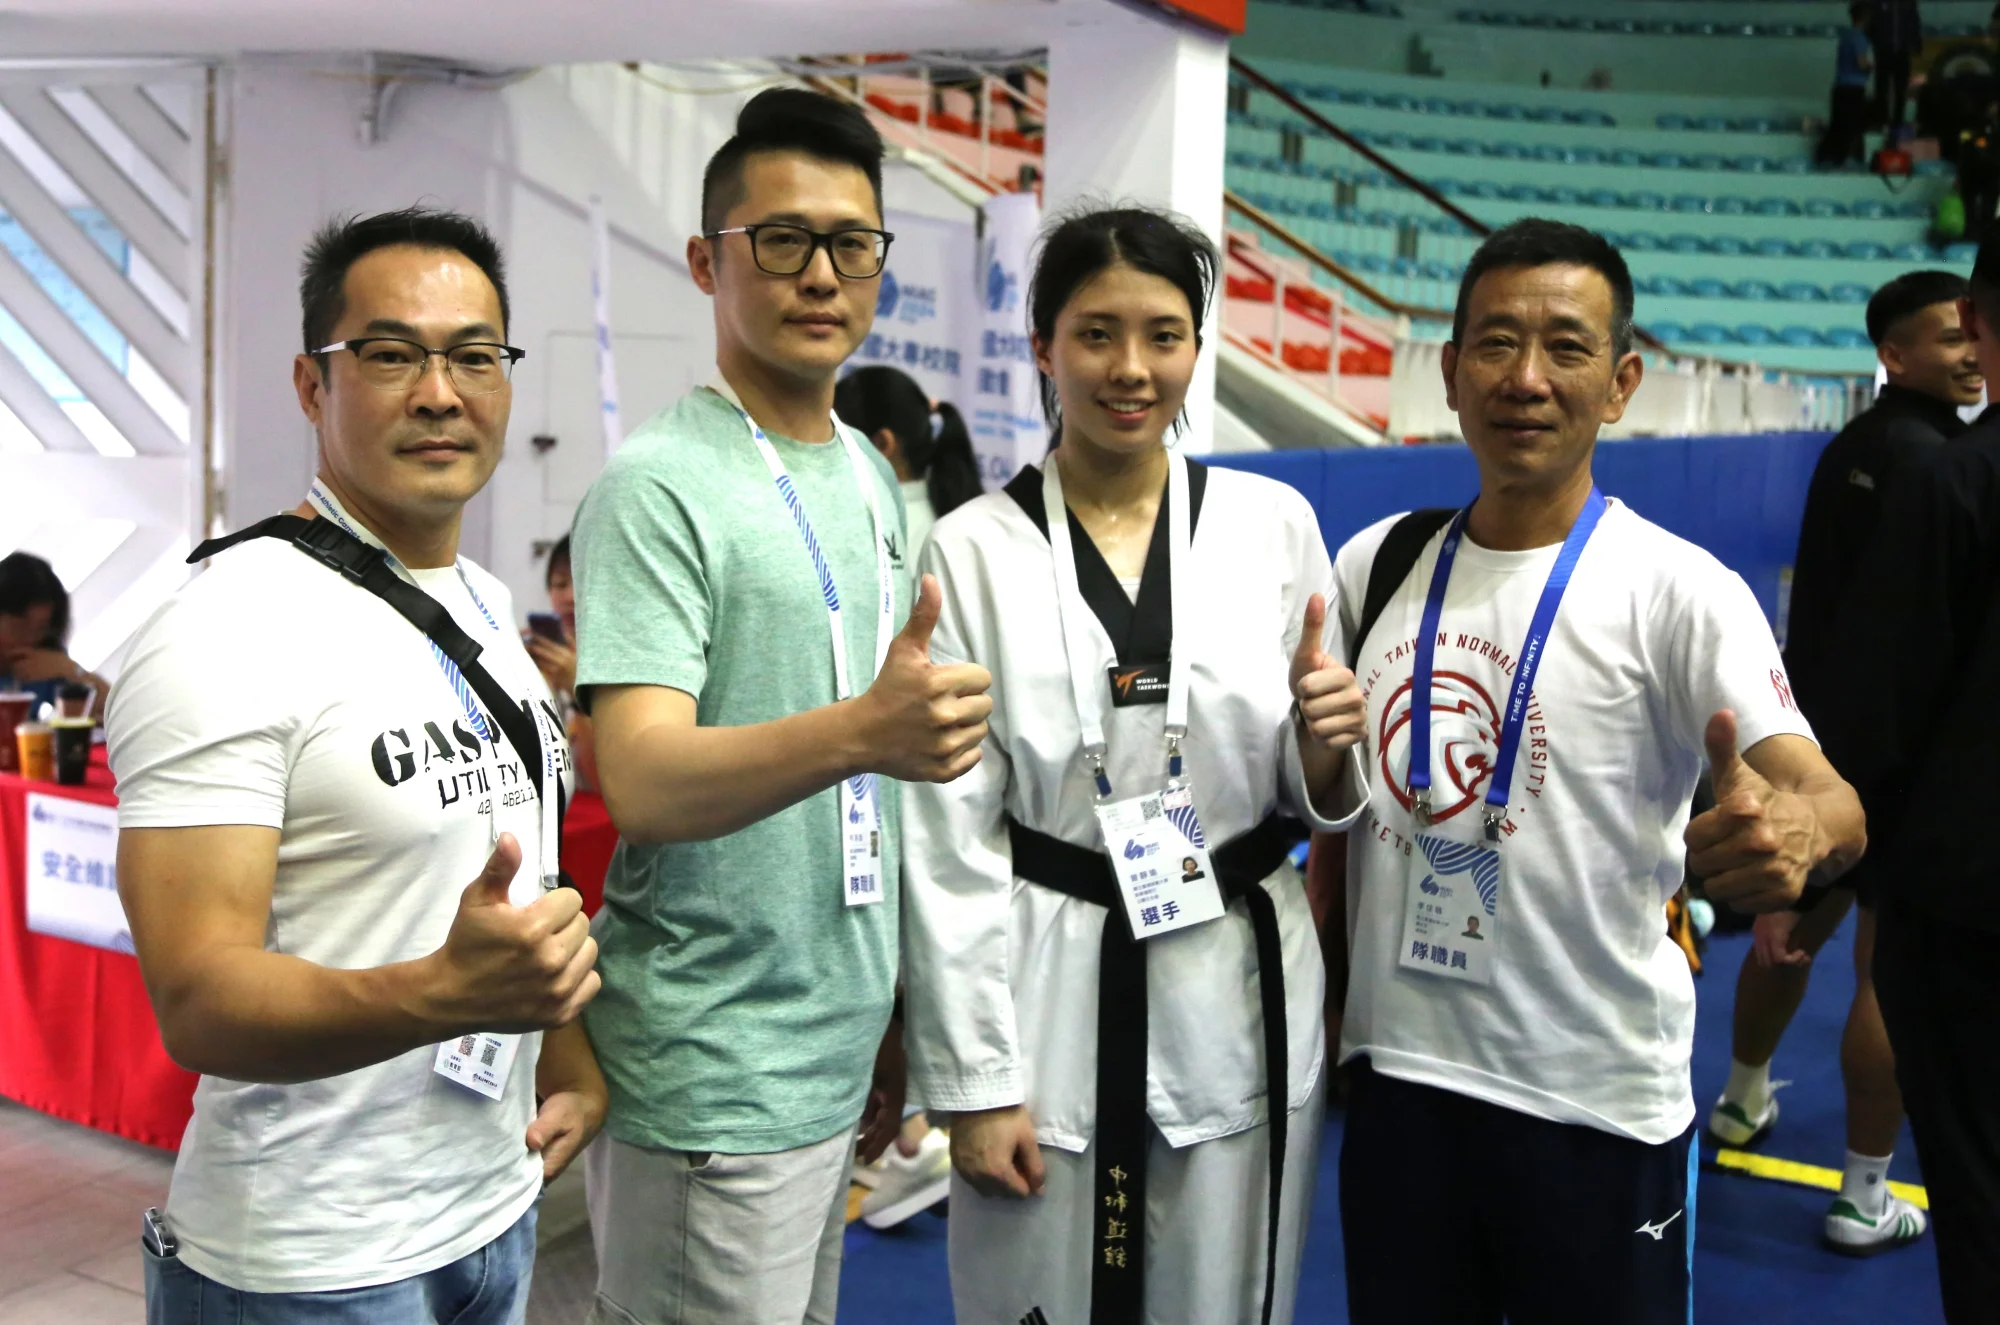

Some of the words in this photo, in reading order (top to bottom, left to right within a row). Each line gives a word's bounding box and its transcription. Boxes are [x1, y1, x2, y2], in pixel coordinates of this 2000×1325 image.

[1456, 633, 1518, 676] NORMAL
[1136, 677, 1159, 685] WORLD
[1510, 697, 1523, 723] TIME
[1517, 682, 1527, 696] TO
[1525, 690, 1548, 799] NIVERSITY
[547, 750, 555, 778] TIME
[1140, 900, 1181, 927] 選手
[1411, 940, 1468, 971] 隊職員
